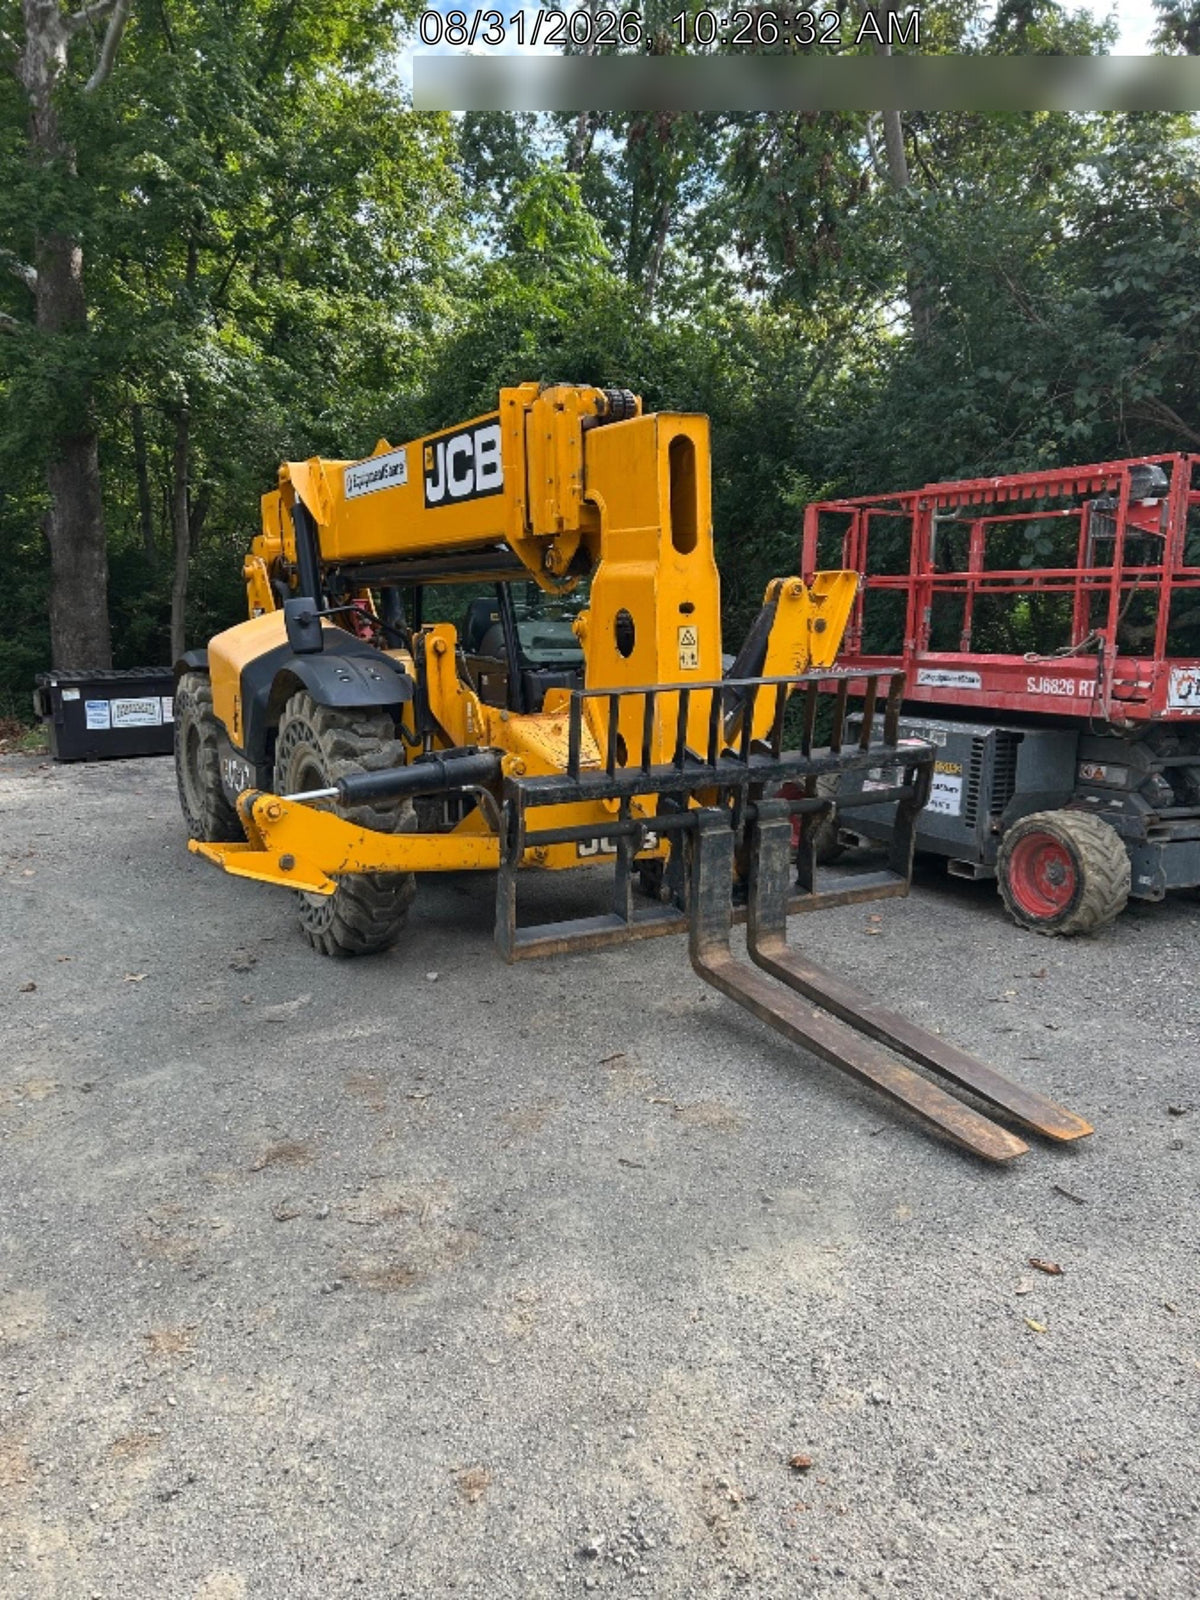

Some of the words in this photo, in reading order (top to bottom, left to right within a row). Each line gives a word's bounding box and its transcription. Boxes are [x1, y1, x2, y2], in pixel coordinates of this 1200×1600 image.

[426, 424, 504, 502] JCB
[1026, 677, 1075, 696] SJ6826
[1078, 680, 1096, 698] RT
